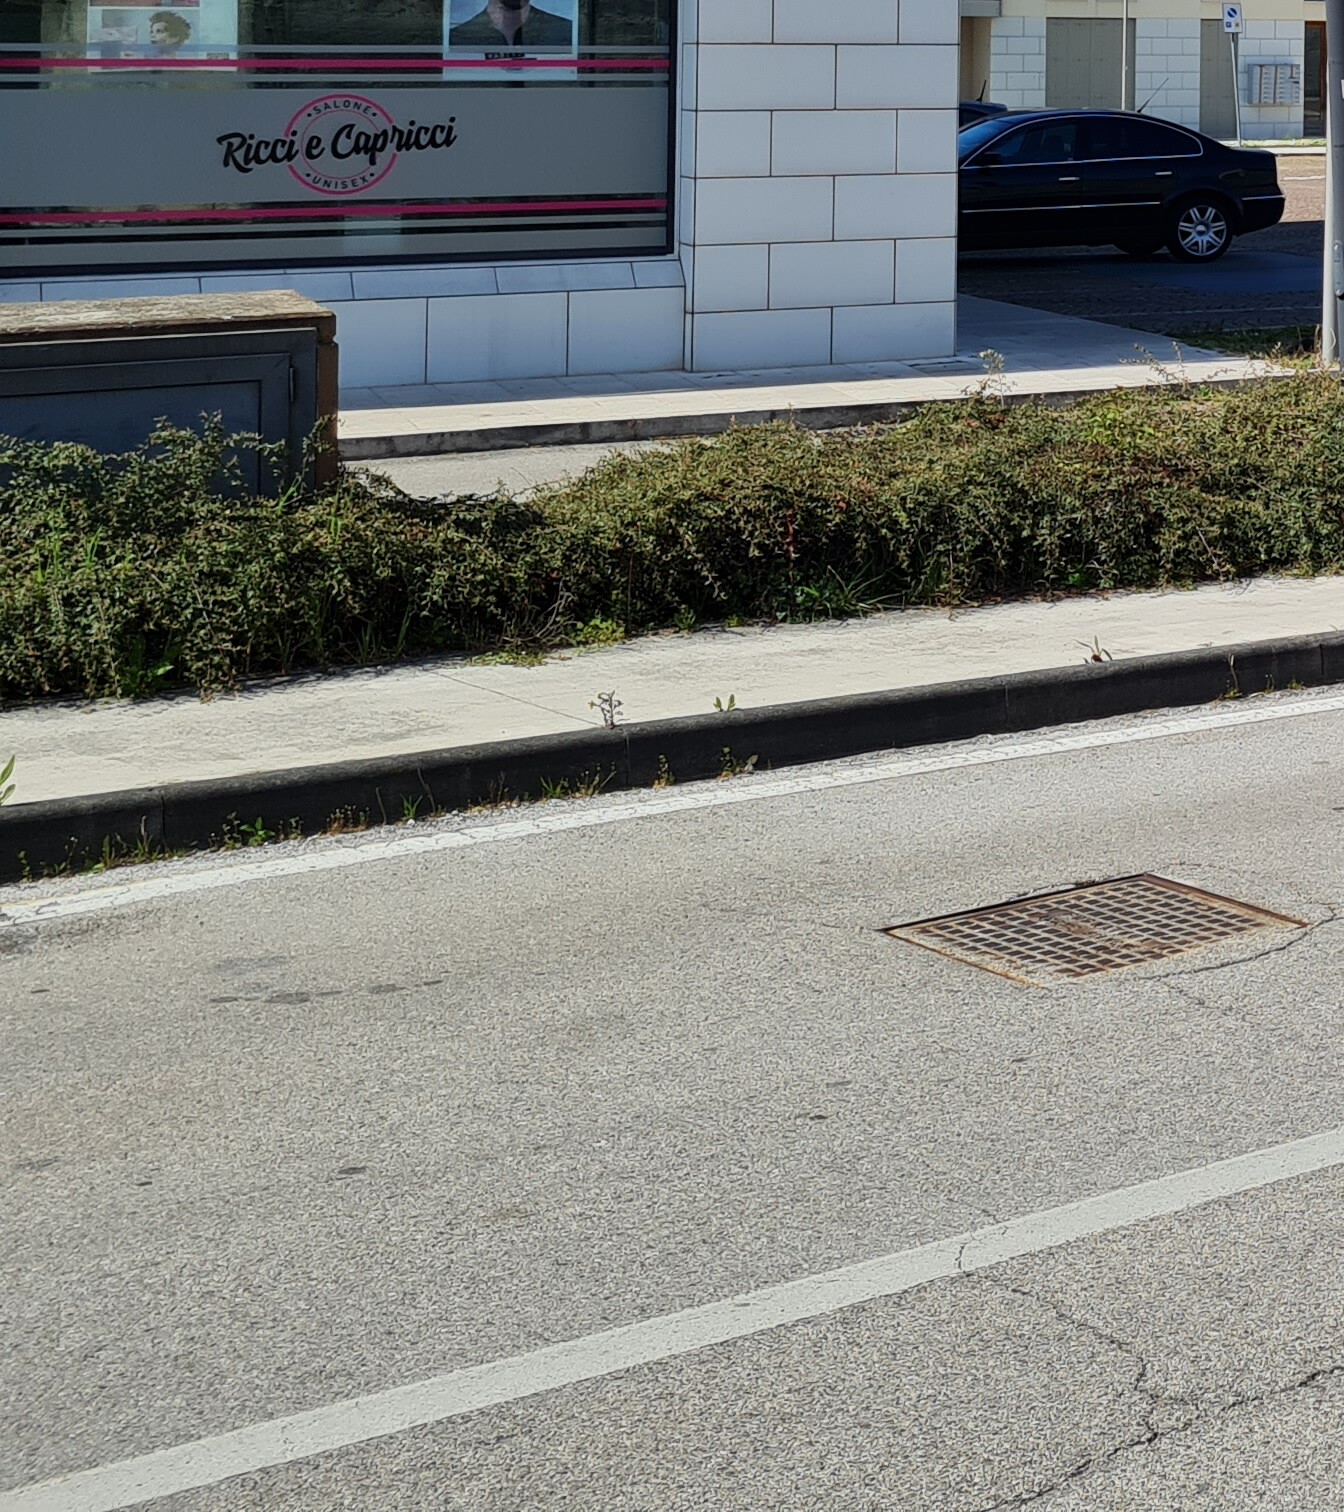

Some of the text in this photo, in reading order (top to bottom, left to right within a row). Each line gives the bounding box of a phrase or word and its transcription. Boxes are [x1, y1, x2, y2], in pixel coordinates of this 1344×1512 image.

[312, 99, 372, 115] SALONE
[216, 116, 458, 174] Ricci e Capricci
[311, 174, 369, 190] UNISEX
